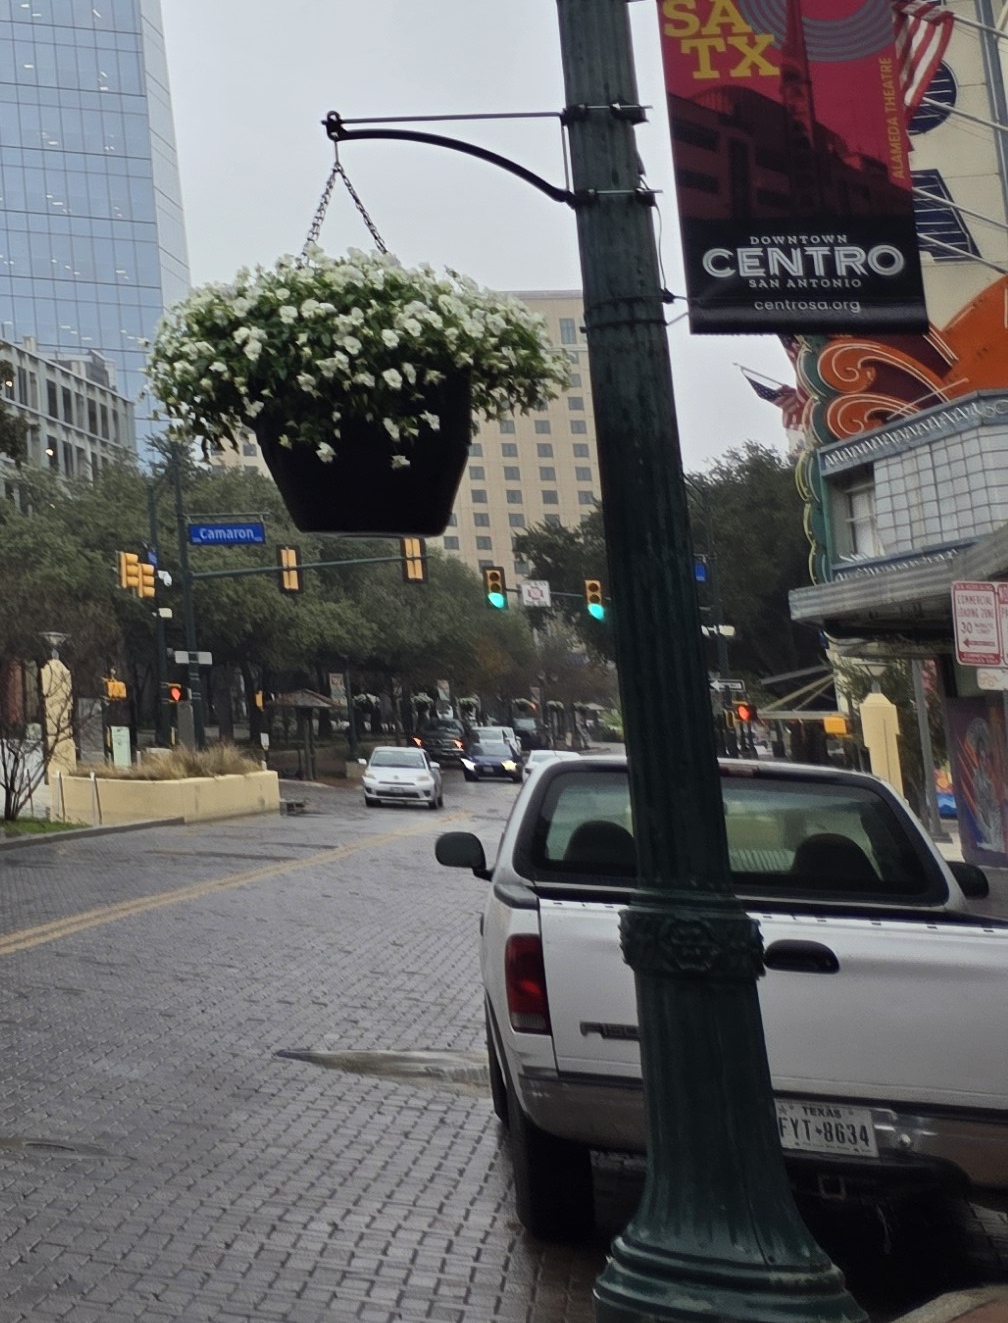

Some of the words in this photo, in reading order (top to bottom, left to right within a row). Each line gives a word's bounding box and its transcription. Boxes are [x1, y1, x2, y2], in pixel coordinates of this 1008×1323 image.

[680, 34, 780, 80] TX
[878, 57, 898, 113] THEATRE
[886, 116, 906, 180] ALAMEDA
[749, 234, 849, 246] DOWNTOWN
[701, 244, 905, 279] CENTRO
[748, 278, 781, 289] SAN
[785, 278, 863, 289] ANTONIO
[753, 299, 862, 314] centrosa.org
[198, 527, 255, 541] Camaron
[960, 621, 973, 634] 30
[801, 1105, 843, 1119] TEXAS
